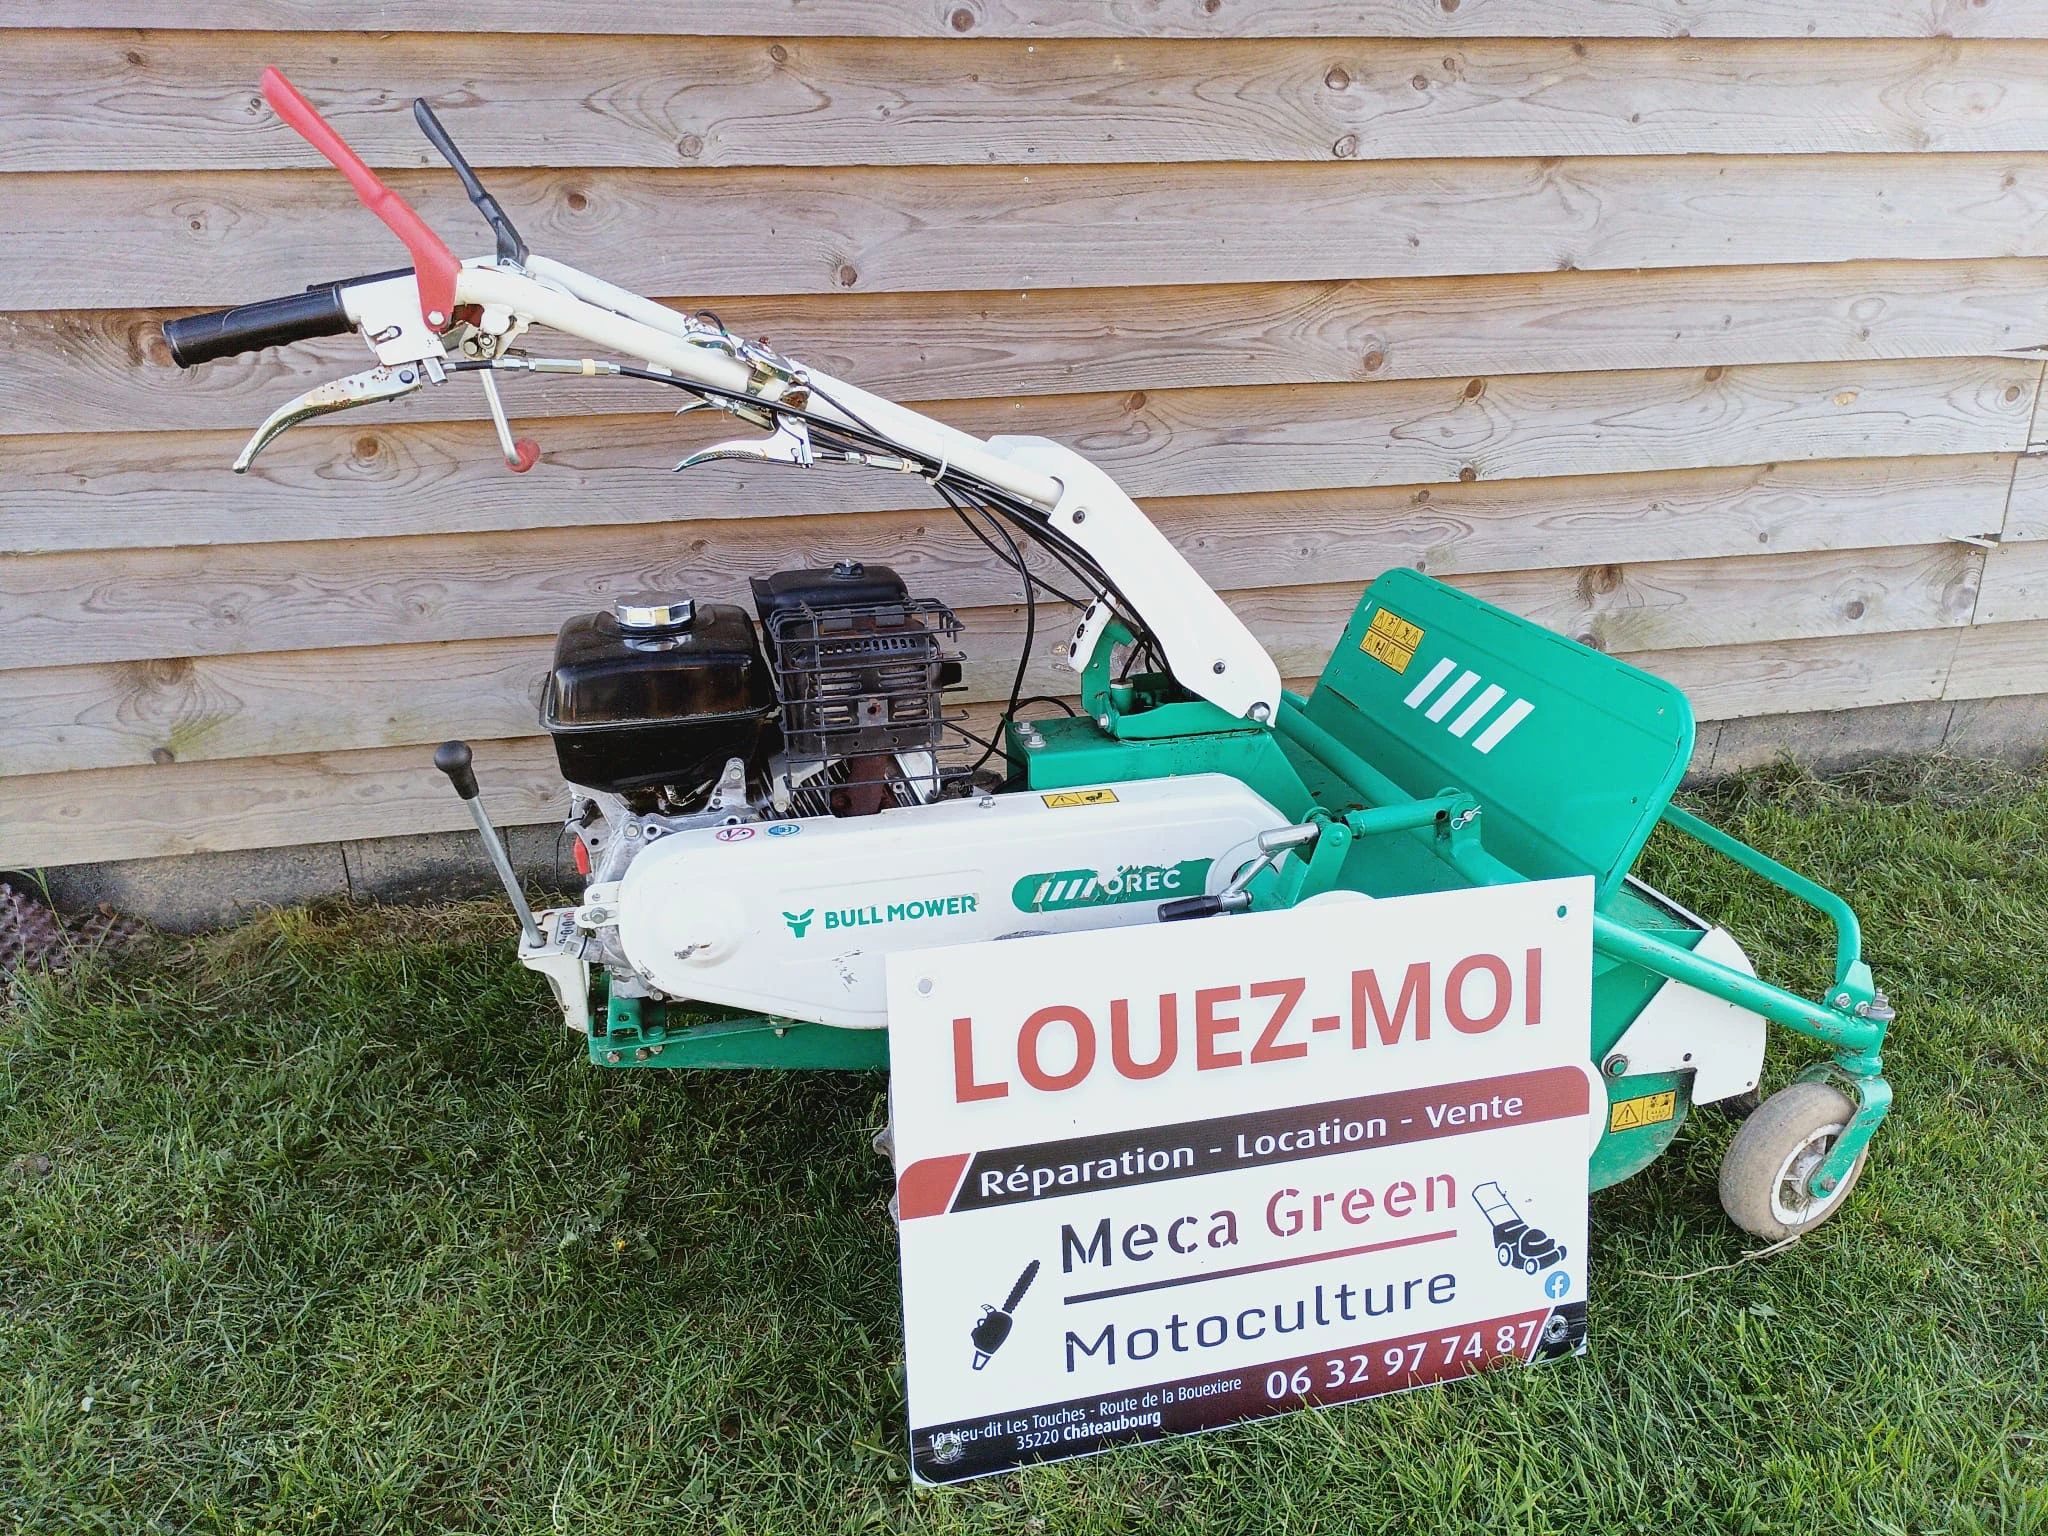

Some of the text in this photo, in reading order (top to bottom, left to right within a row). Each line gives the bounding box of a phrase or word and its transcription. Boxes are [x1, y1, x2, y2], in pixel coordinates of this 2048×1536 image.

[825, 895, 977, 930] BULL MOWER
[952, 947, 1541, 1103] LOUEZ-MOI
[980, 1146, 1195, 1198] Réparation
[1237, 1116, 1387, 1160] Location
[1425, 1095, 1524, 1130] Vente
[1061, 1174, 1457, 1274] Meca Green
[1064, 1272, 1457, 1374] Motoculture
[1266, 1319, 1538, 1399] 06 32 97 74 87
[1006, 1419, 1029, 1434] Les
[1032, 1408, 1086, 1429] Touches
[1099, 1397, 1138, 1417] Route
[1141, 1391, 1159, 1408] de
[1162, 1388, 1174, 1405] la
[1178, 1378, 1242, 1401] Bouexiere
[1016, 1411, 1162, 1451] 35220 Châteaubourg
